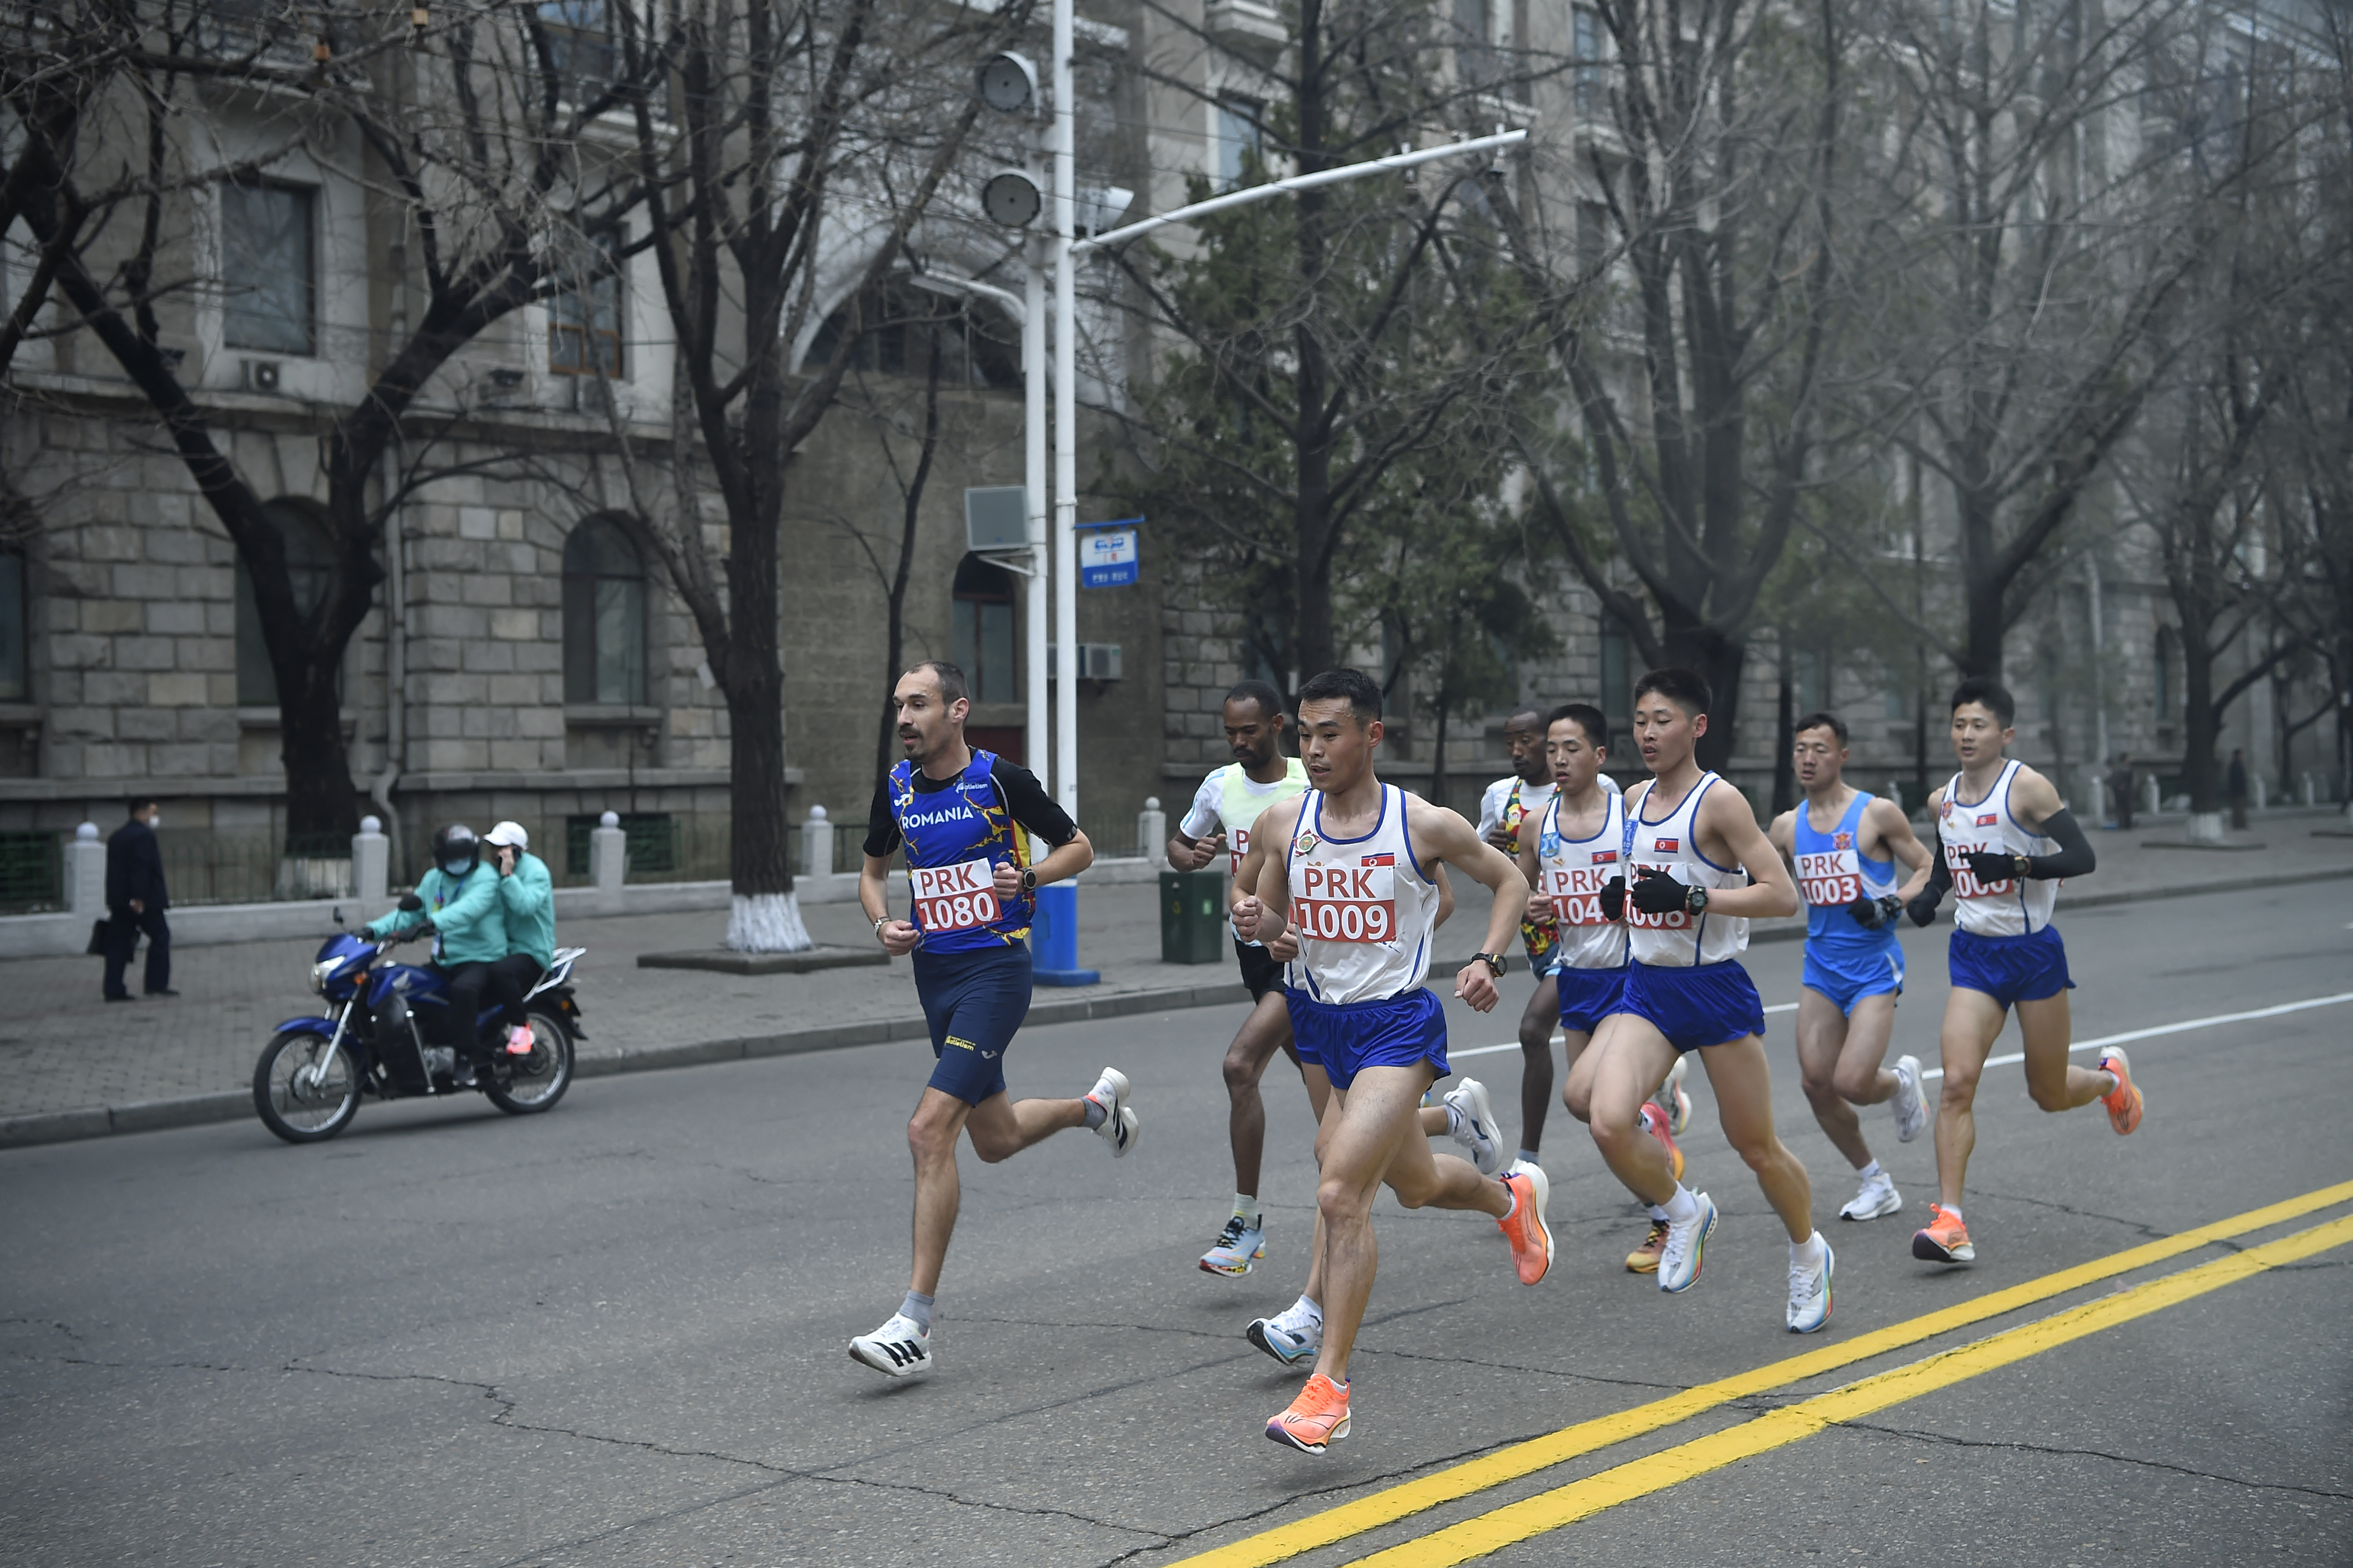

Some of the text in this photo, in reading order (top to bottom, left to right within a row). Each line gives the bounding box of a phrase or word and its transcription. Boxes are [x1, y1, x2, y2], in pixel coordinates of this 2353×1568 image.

[902, 806, 973, 829] ROMANIA
[1801, 853, 1846, 876] PRK
[920, 864, 979, 895] PRK
[1304, 868, 1376, 898] PRK
[1554, 867, 1606, 893] PRK
[1802, 876, 1858, 905] 1003
[919, 892, 994, 930] 1080
[1299, 902, 1388, 940] 1009
[1553, 895, 1609, 924] 104
